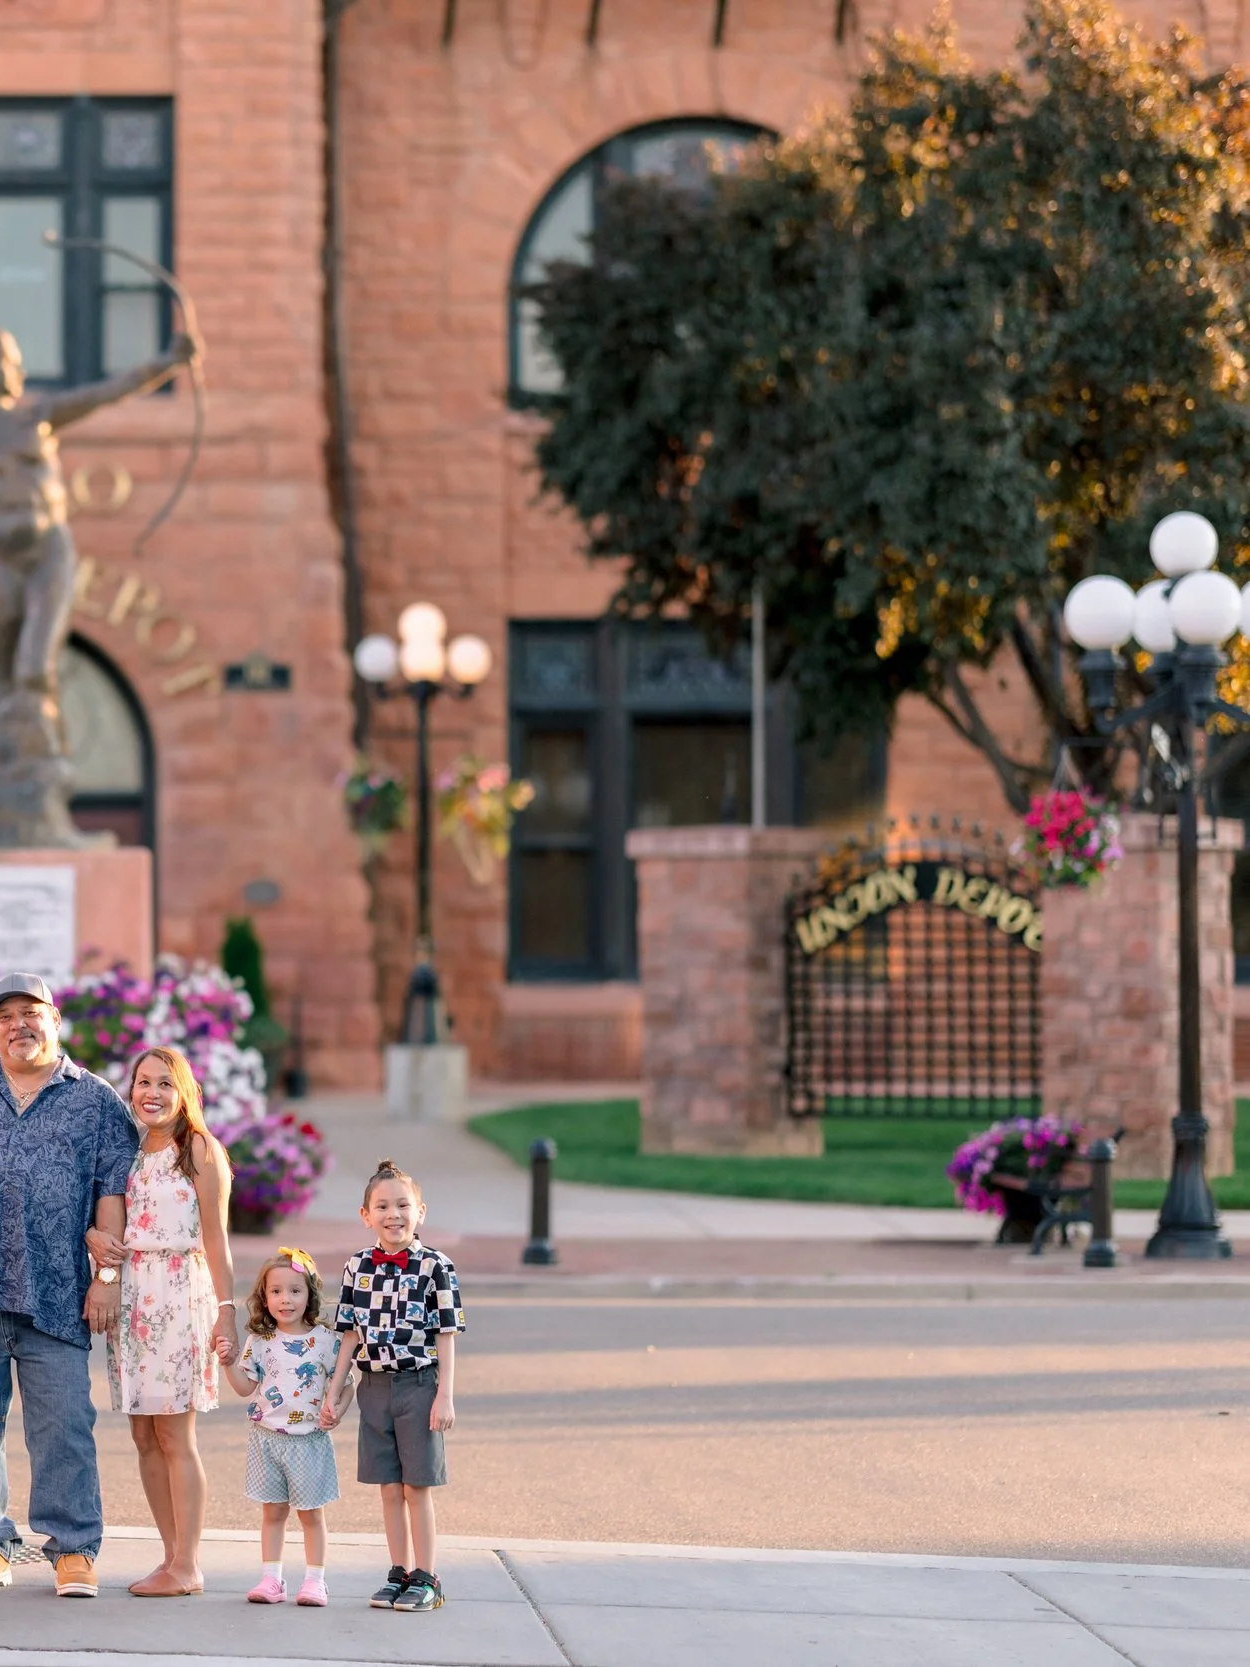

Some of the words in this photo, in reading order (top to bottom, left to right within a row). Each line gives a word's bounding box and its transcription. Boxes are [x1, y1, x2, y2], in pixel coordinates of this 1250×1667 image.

[72, 556, 225, 698] EPOT
[796, 866, 918, 953] UNION
[265, 1385, 283, 1408] S
